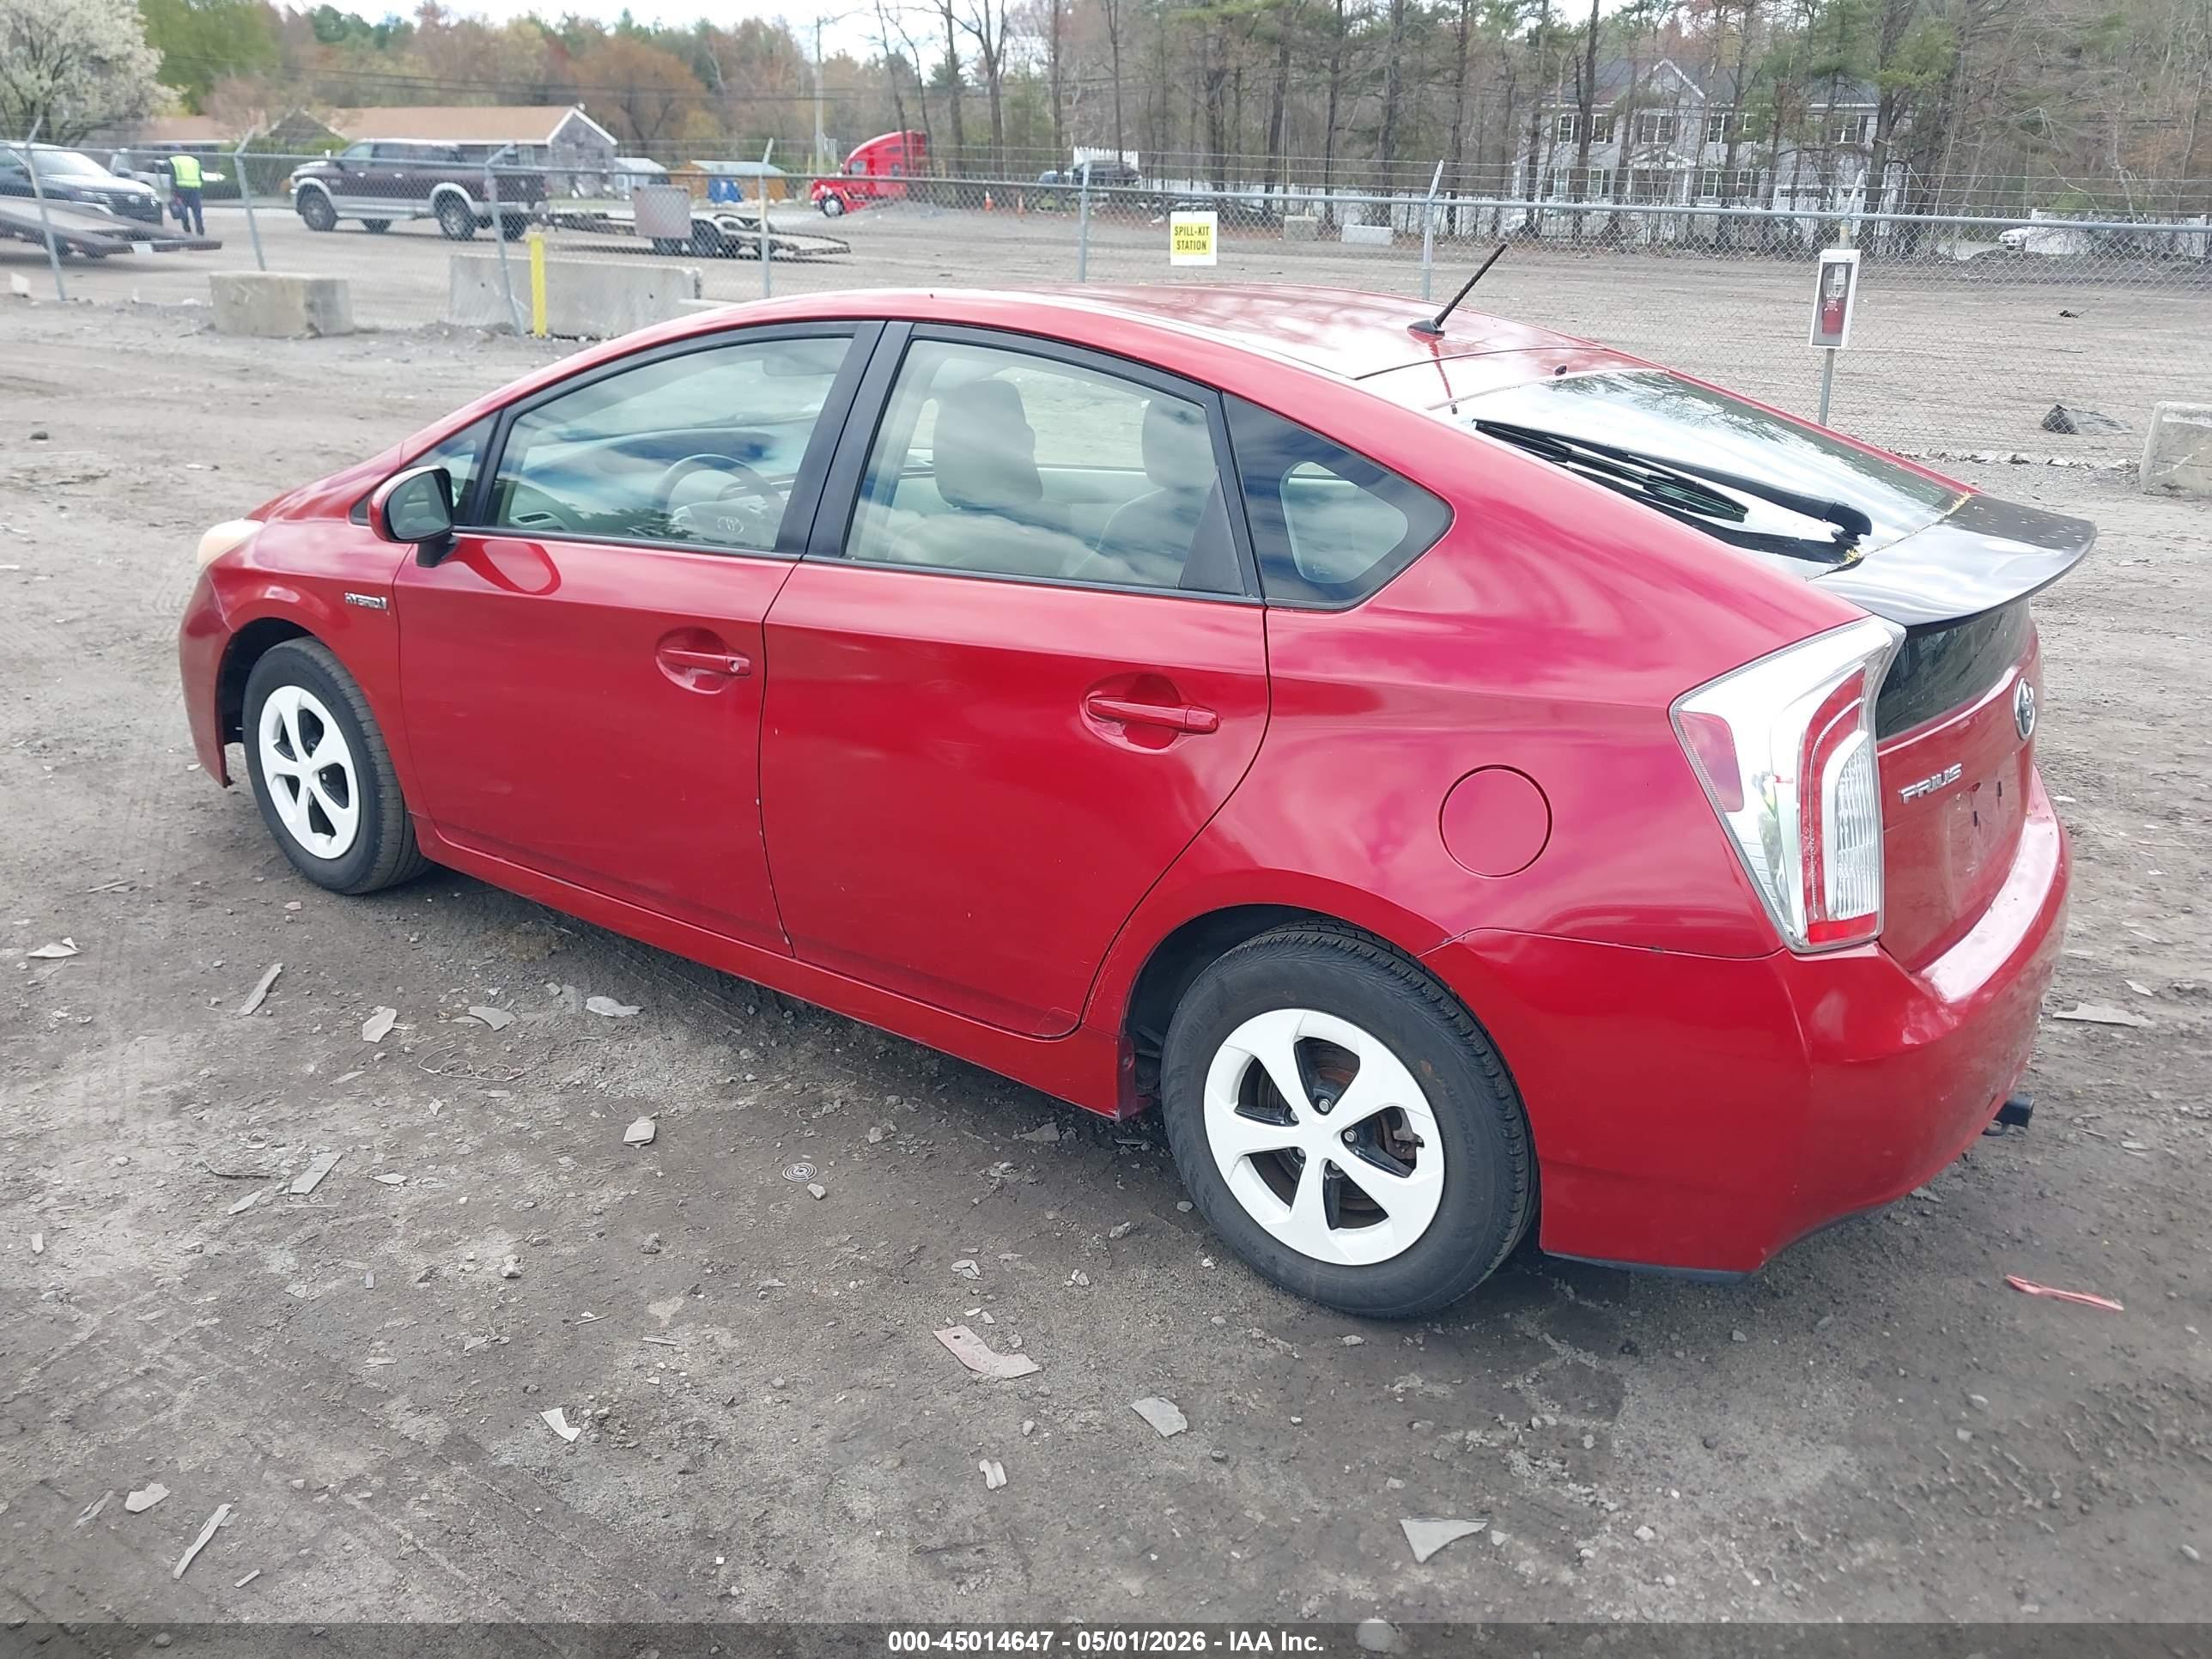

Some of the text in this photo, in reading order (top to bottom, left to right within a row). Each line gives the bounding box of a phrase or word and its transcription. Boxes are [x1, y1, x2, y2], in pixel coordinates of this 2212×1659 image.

[1174, 225, 1210, 237] SPILL-KIT
[1176, 240, 1207, 251] STATION
[1898, 763, 1962, 804] PRIUS
